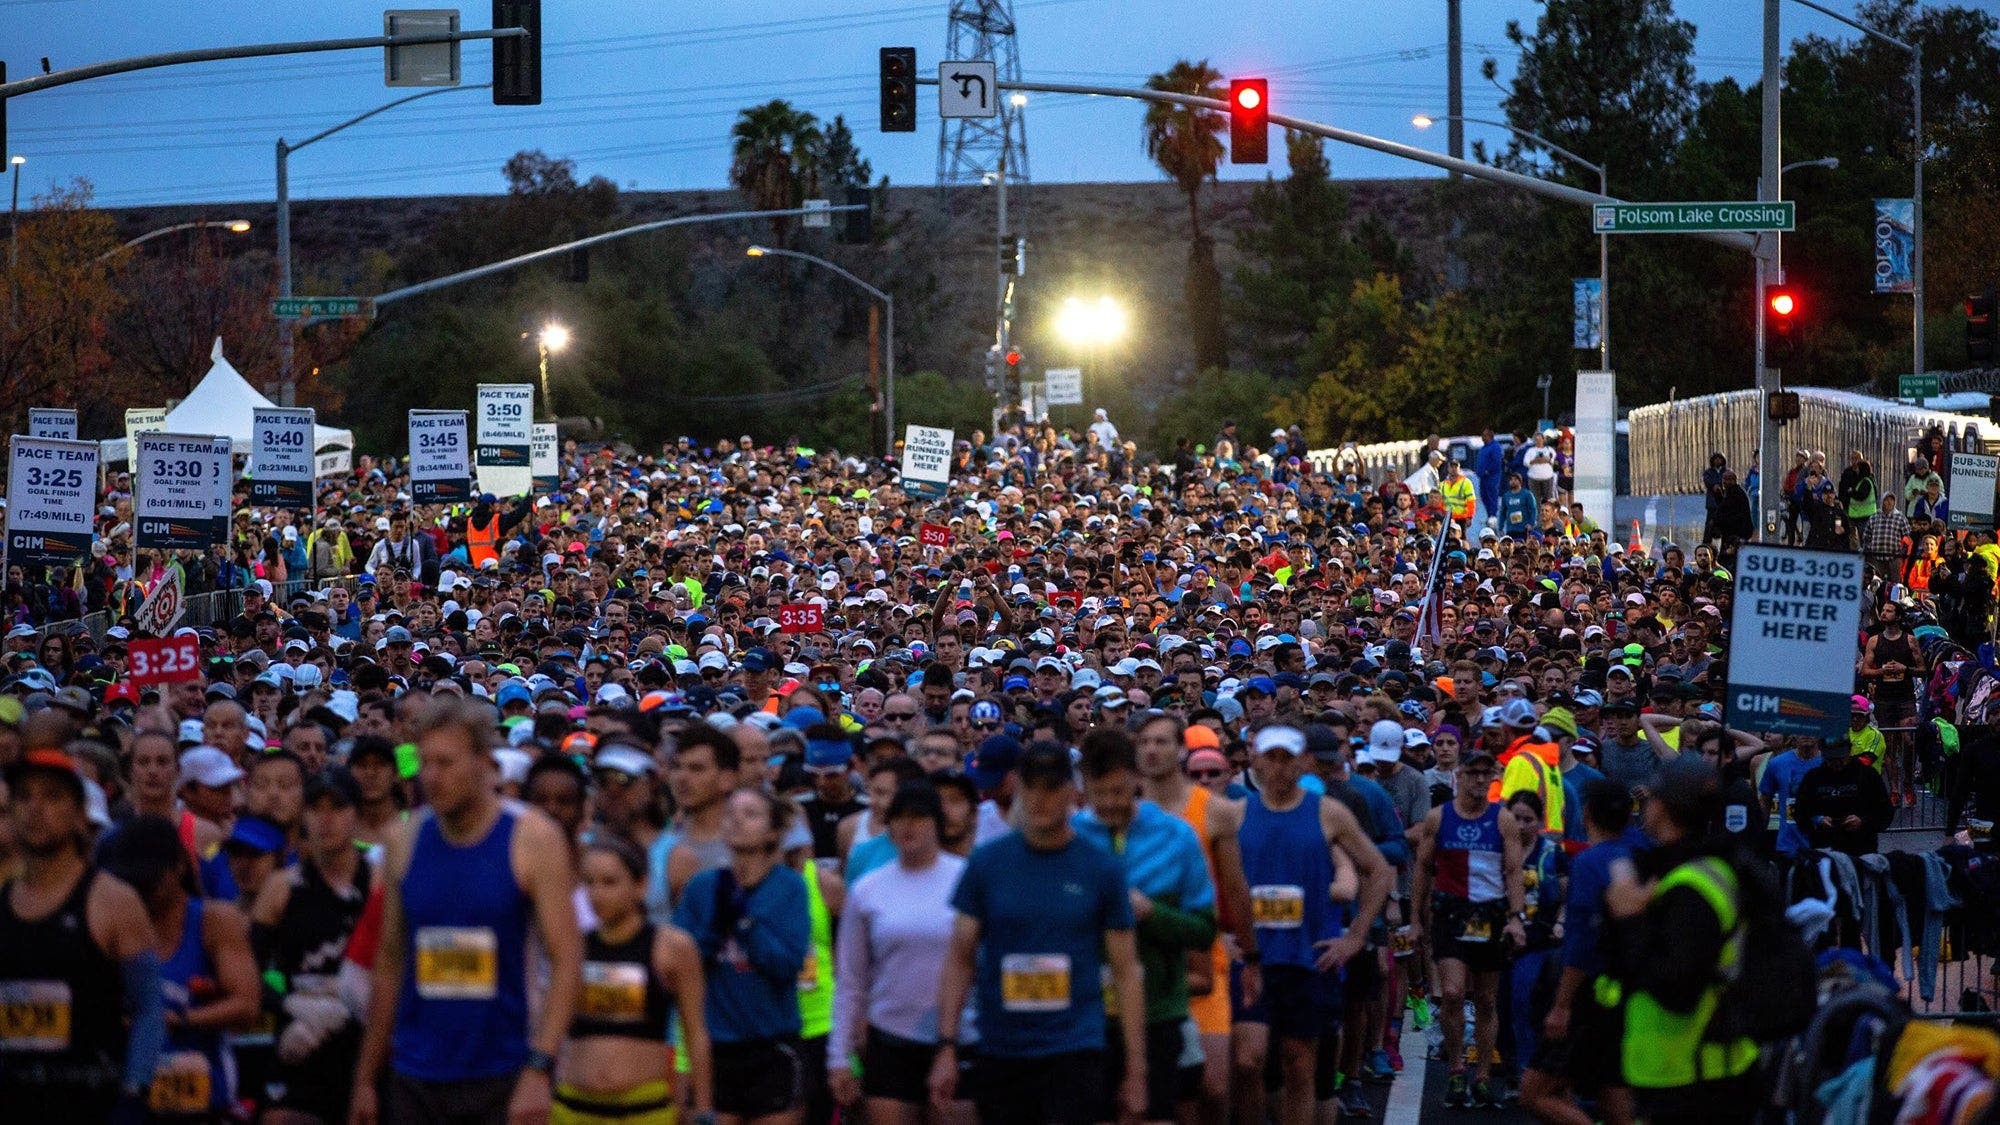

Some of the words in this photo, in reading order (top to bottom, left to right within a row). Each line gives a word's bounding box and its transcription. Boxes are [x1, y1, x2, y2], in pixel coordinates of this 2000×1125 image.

[1619, 208, 1674, 224] Folsom
[1678, 207, 1714, 223] Lake
[1718, 206, 1786, 226] Crossing
[1876, 205, 1893, 287] FOLSOM
[480, 391, 502, 399] PACE
[505, 391, 529, 399] TEAM
[487, 403, 522, 416] 3:50
[33, 416, 53, 425] PACE
[54, 417, 76, 426] TEAM
[127, 415, 144, 425] PACE
[146, 413, 166, 424] TEAM
[255, 415, 280, 424] PACE
[286, 416, 312, 425] TEAM
[411, 419, 435, 428] PACE
[438, 418, 465, 427] TEAM
[263, 430, 304, 446] 3:40
[419, 432, 458, 447] 3:45
[143, 441, 175, 452] PACE
[179, 442, 212, 454] TEAM
[480, 447, 501, 457] CIM
[906, 444, 950, 457] RUNNERS
[17, 447, 52, 461] PACE
[57, 449, 95, 463] TEAM
[911, 453, 943, 463] ENTER
[153, 459, 203, 478] 3:30
[258, 463, 308, 473] (8:23/MILE)
[913, 462, 939, 471] HERE
[1953, 456, 1997, 468] SUB-3:30
[27, 467, 82, 487] 3:25
[1952, 467, 1996, 479] RUNNERS
[27, 488, 51, 497] GOAL
[52, 489, 80, 498] FINISH
[254, 484, 277, 495] CIM
[414, 483, 436, 494] CIM
[43, 497, 63, 506] TIME
[146, 498, 206, 511] (8:01/MILE)
[18, 508, 86, 524] (7:49/MILE)
[1951, 513, 1967, 523] CIM
[142, 521, 170, 535] CIM
[13, 535, 44, 550] CIM
[923, 529, 946, 543] 3:50
[1745, 554, 1855, 580] SUB-3:05
[1739, 576, 1858, 601] RUNNERS
[1756, 598, 1838, 621] ENTER
[782, 609, 818, 626] 3:35
[1762, 620, 1829, 642] HERE
[132, 645, 196, 677] 3:25
[1736, 693, 1780, 713] CIM
